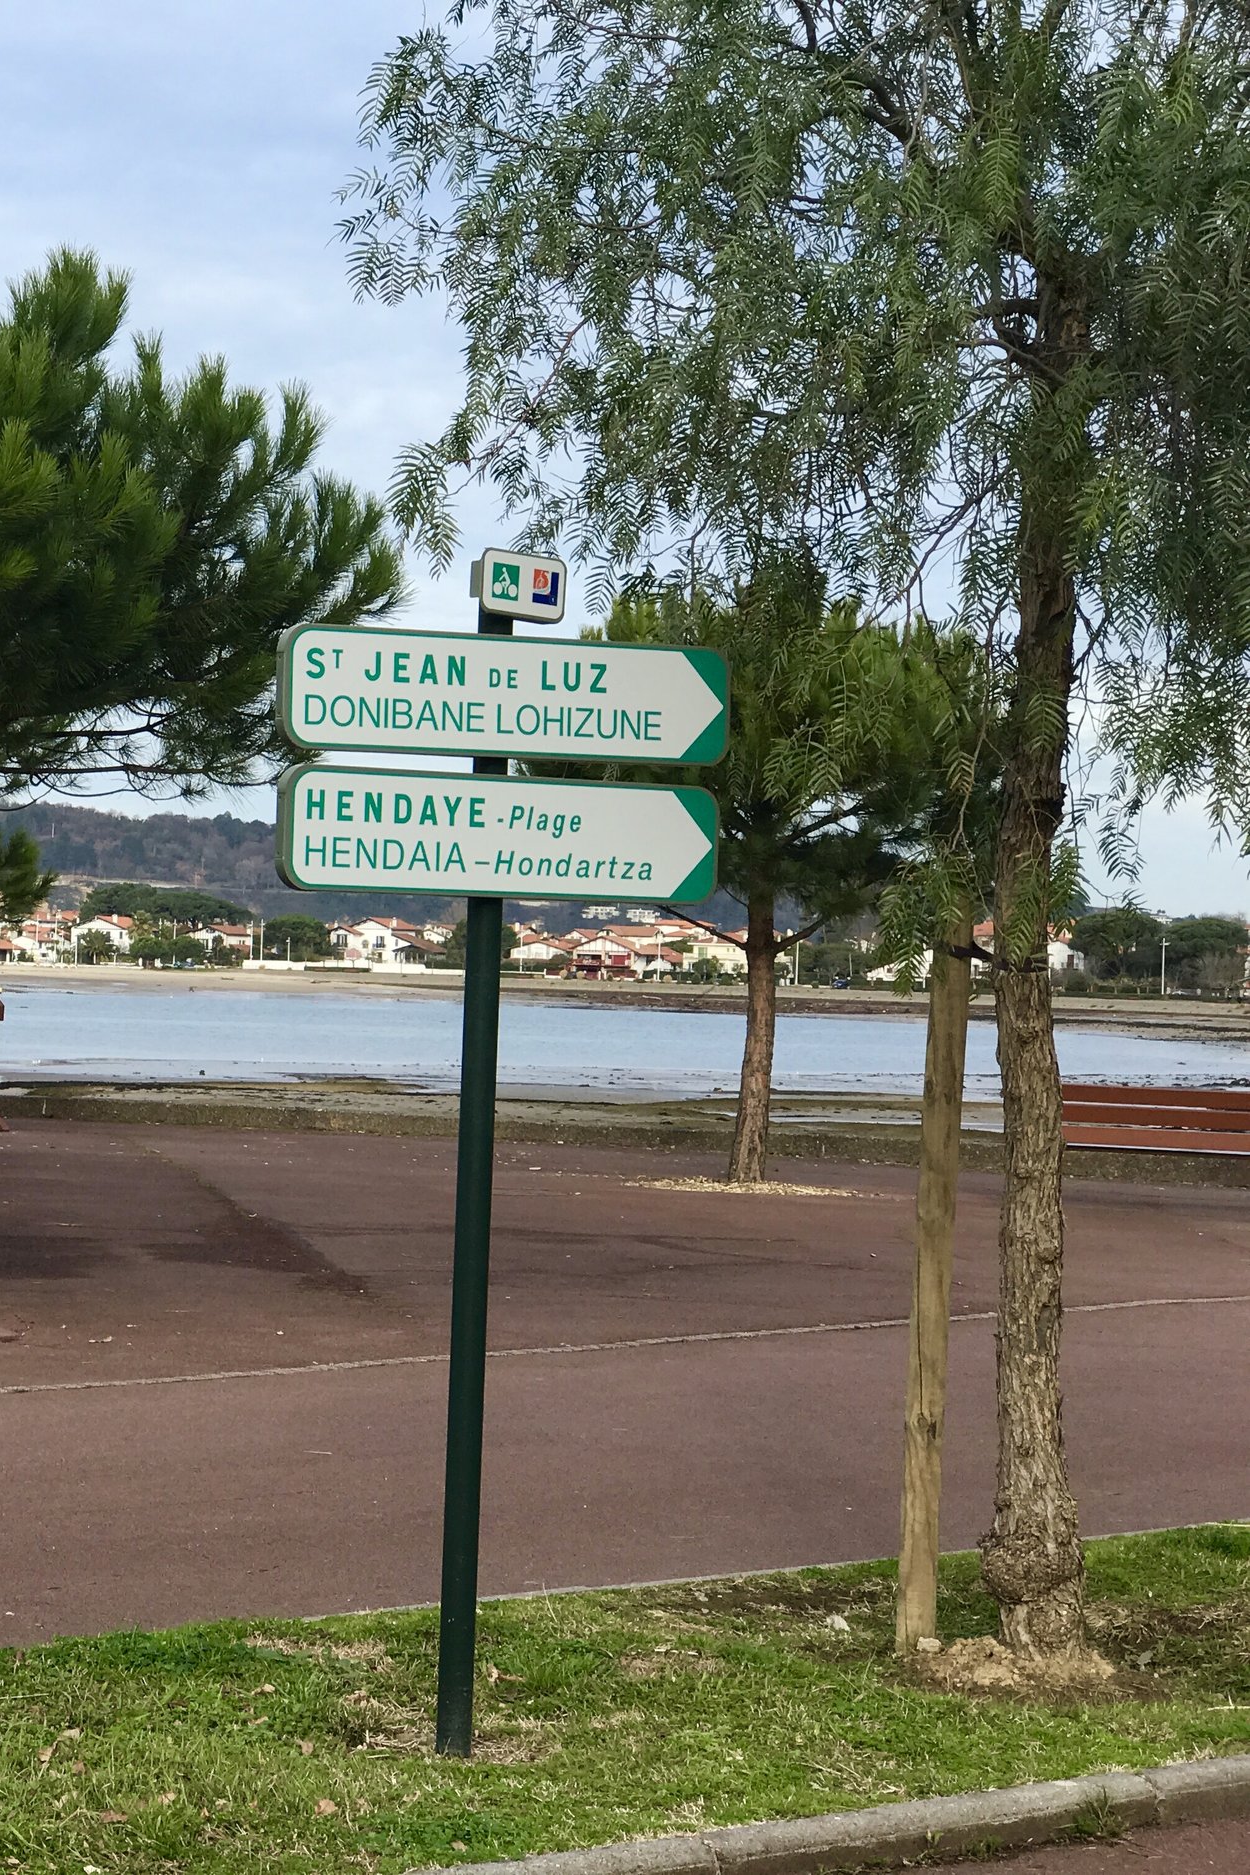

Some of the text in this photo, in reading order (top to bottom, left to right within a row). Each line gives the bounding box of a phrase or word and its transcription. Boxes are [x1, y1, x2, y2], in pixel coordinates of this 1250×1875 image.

[364, 651, 467, 687] JEAN
[488, 667, 519, 689] DE
[541, 660, 608, 694] LUZ
[303, 693, 662, 741] DONIBANE LOHIZUNE
[305, 788, 487, 829] HENDAYE
[304, 835, 467, 873] HENDAIA
